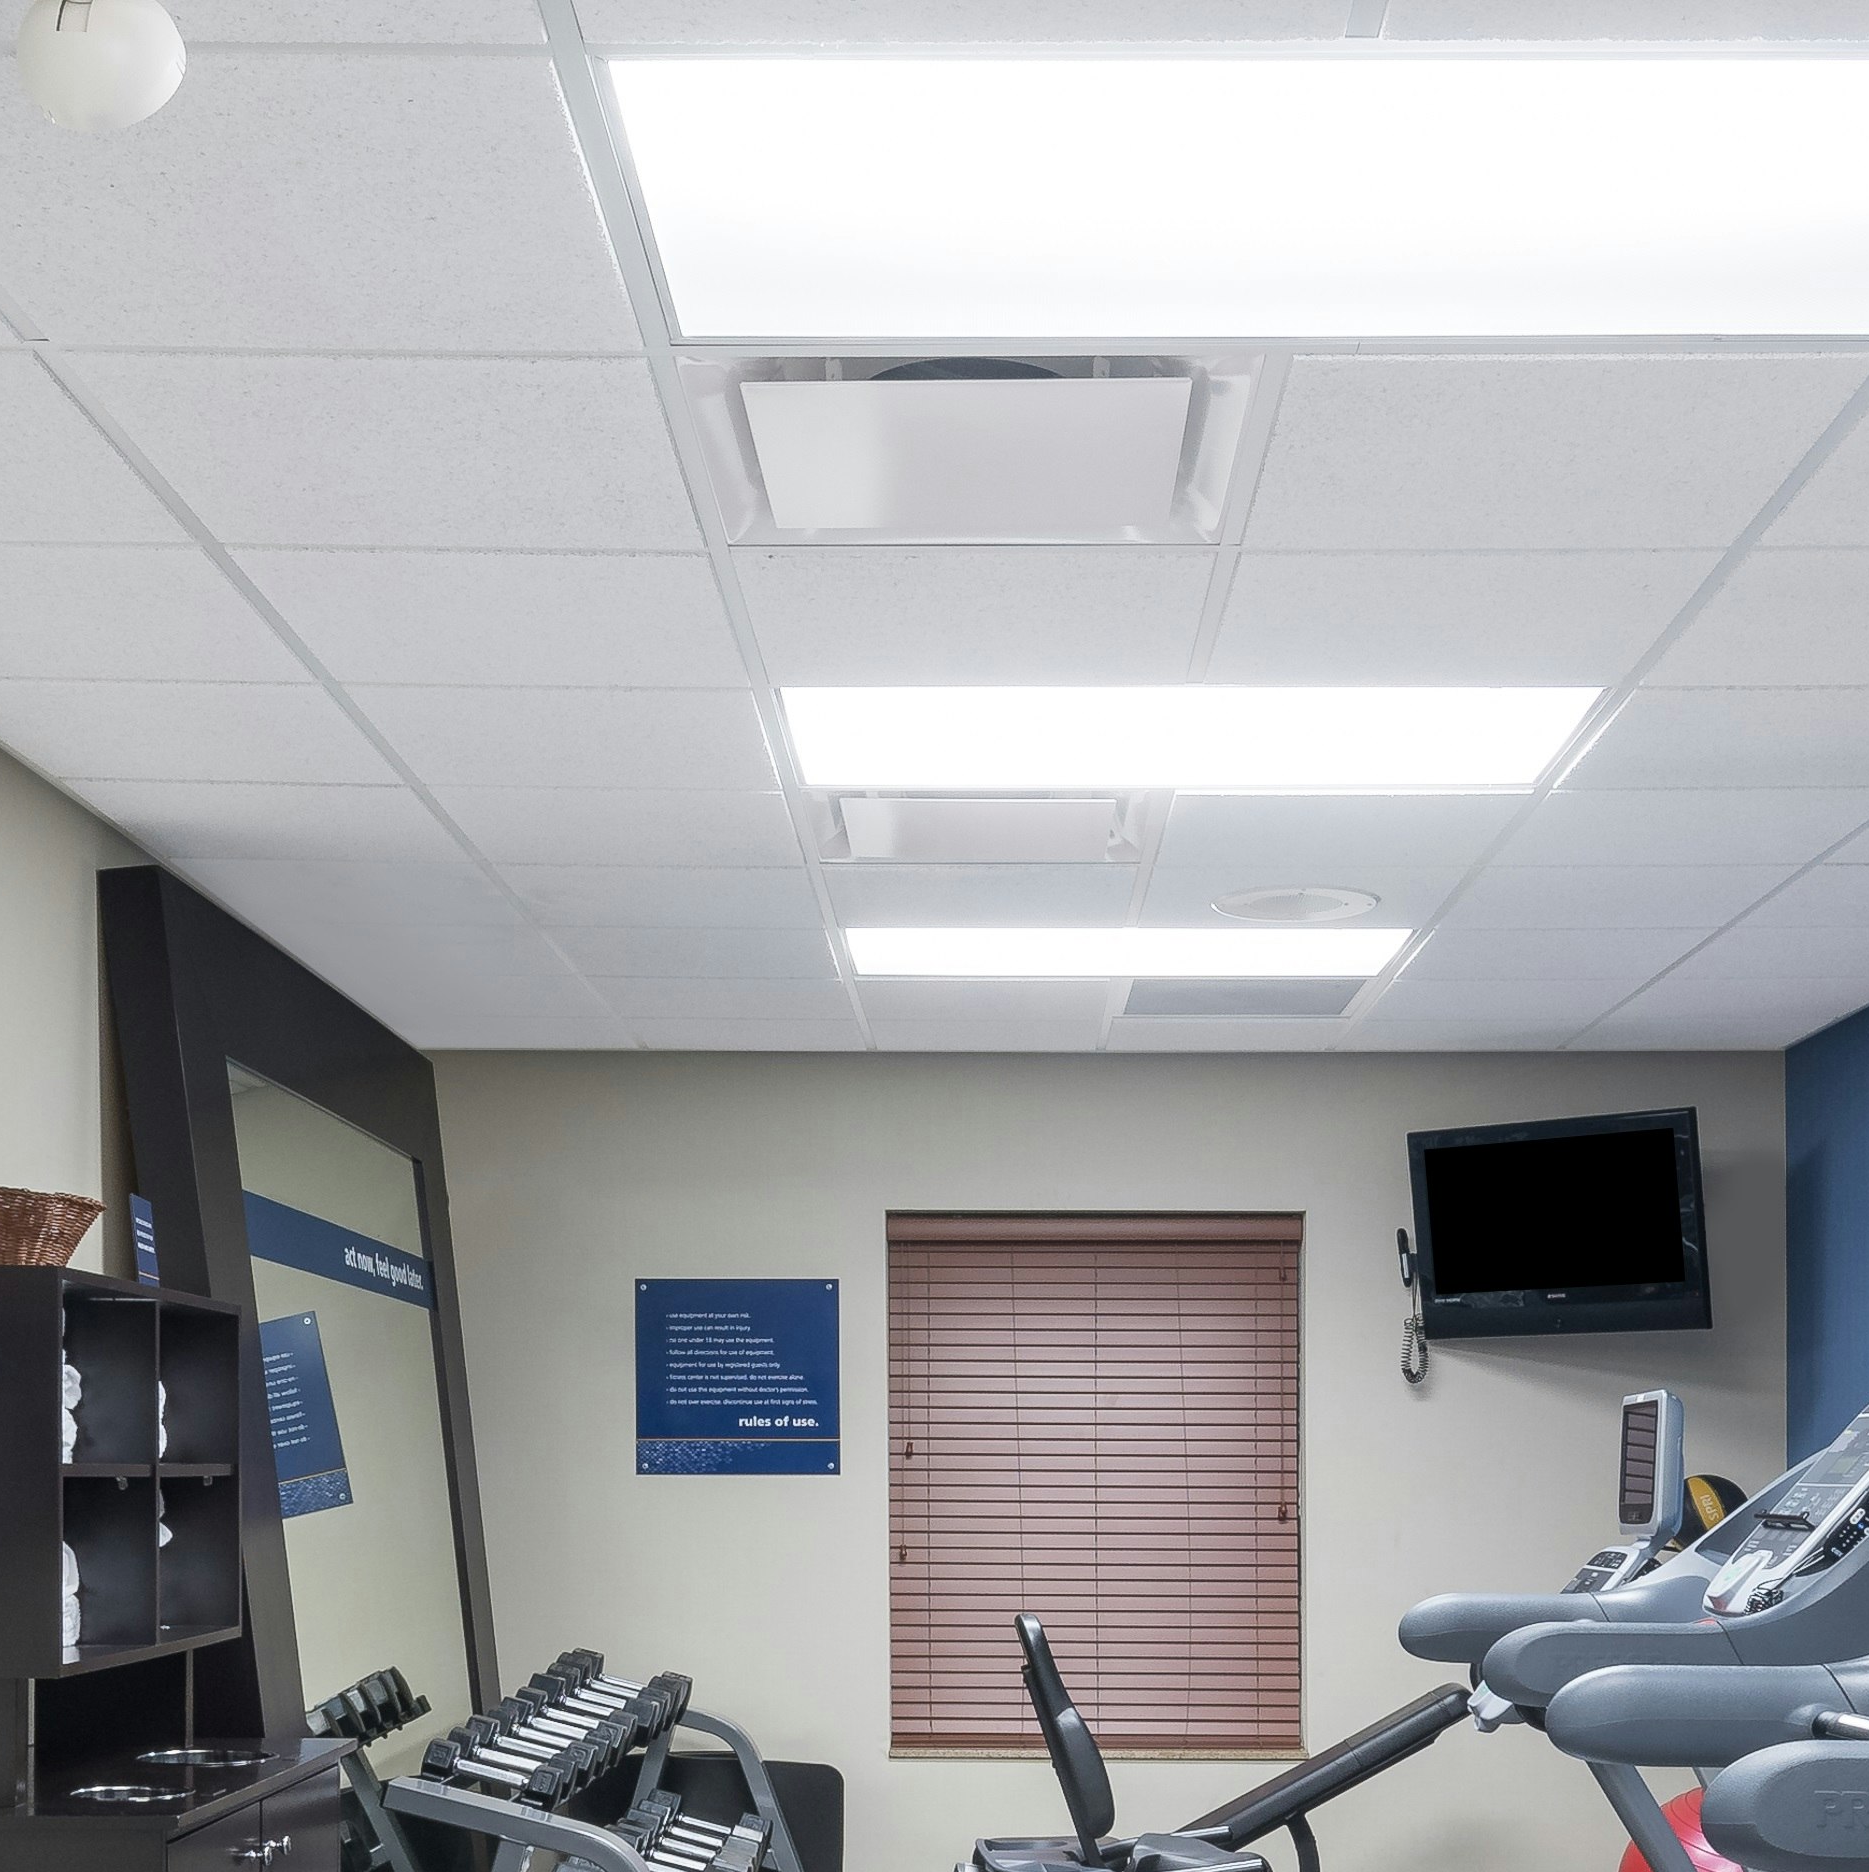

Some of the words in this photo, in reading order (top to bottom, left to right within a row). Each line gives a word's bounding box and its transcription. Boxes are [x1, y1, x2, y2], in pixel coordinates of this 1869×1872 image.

[344, 1246, 358, 1269] act
[357, 1252, 376, 1277] now,
[375, 1252, 390, 1279] feel
[390, 1262, 407, 1287] good
[738, 1415, 771, 1427] rules
[774, 1415, 789, 1427] of
[792, 1417, 819, 1427] use.
[1700, 1495, 1720, 1522] SPRI
